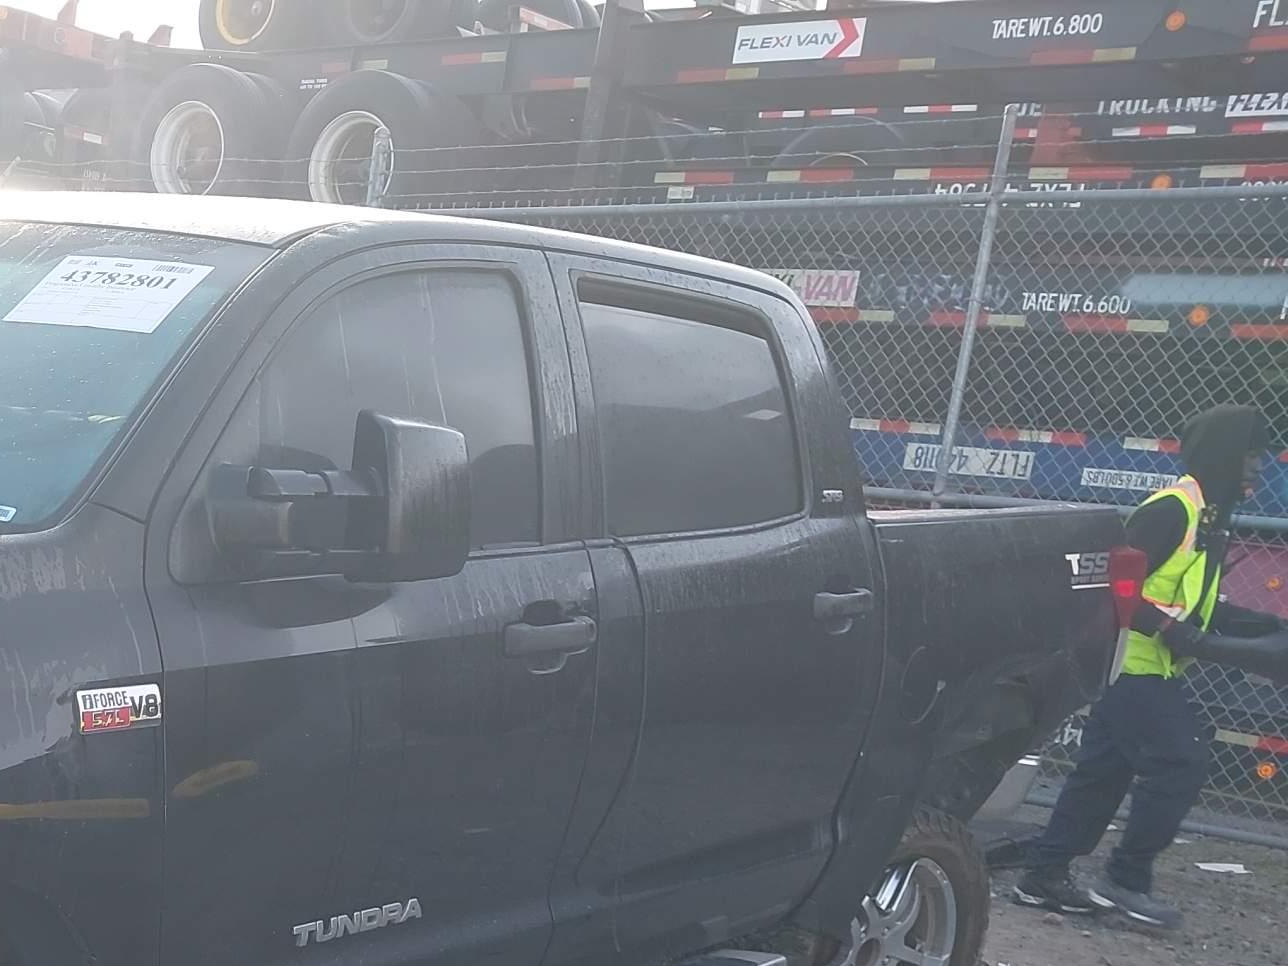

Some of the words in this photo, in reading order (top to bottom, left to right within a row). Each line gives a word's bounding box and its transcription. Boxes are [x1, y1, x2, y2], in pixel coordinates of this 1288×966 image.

[738, 35, 793, 51] FLEXI
[796, 32, 837, 47] VAN
[60, 269, 178, 289] 43782801
[130, 693, 158, 718] V8
[293, 898, 422, 947] TUNDRA
